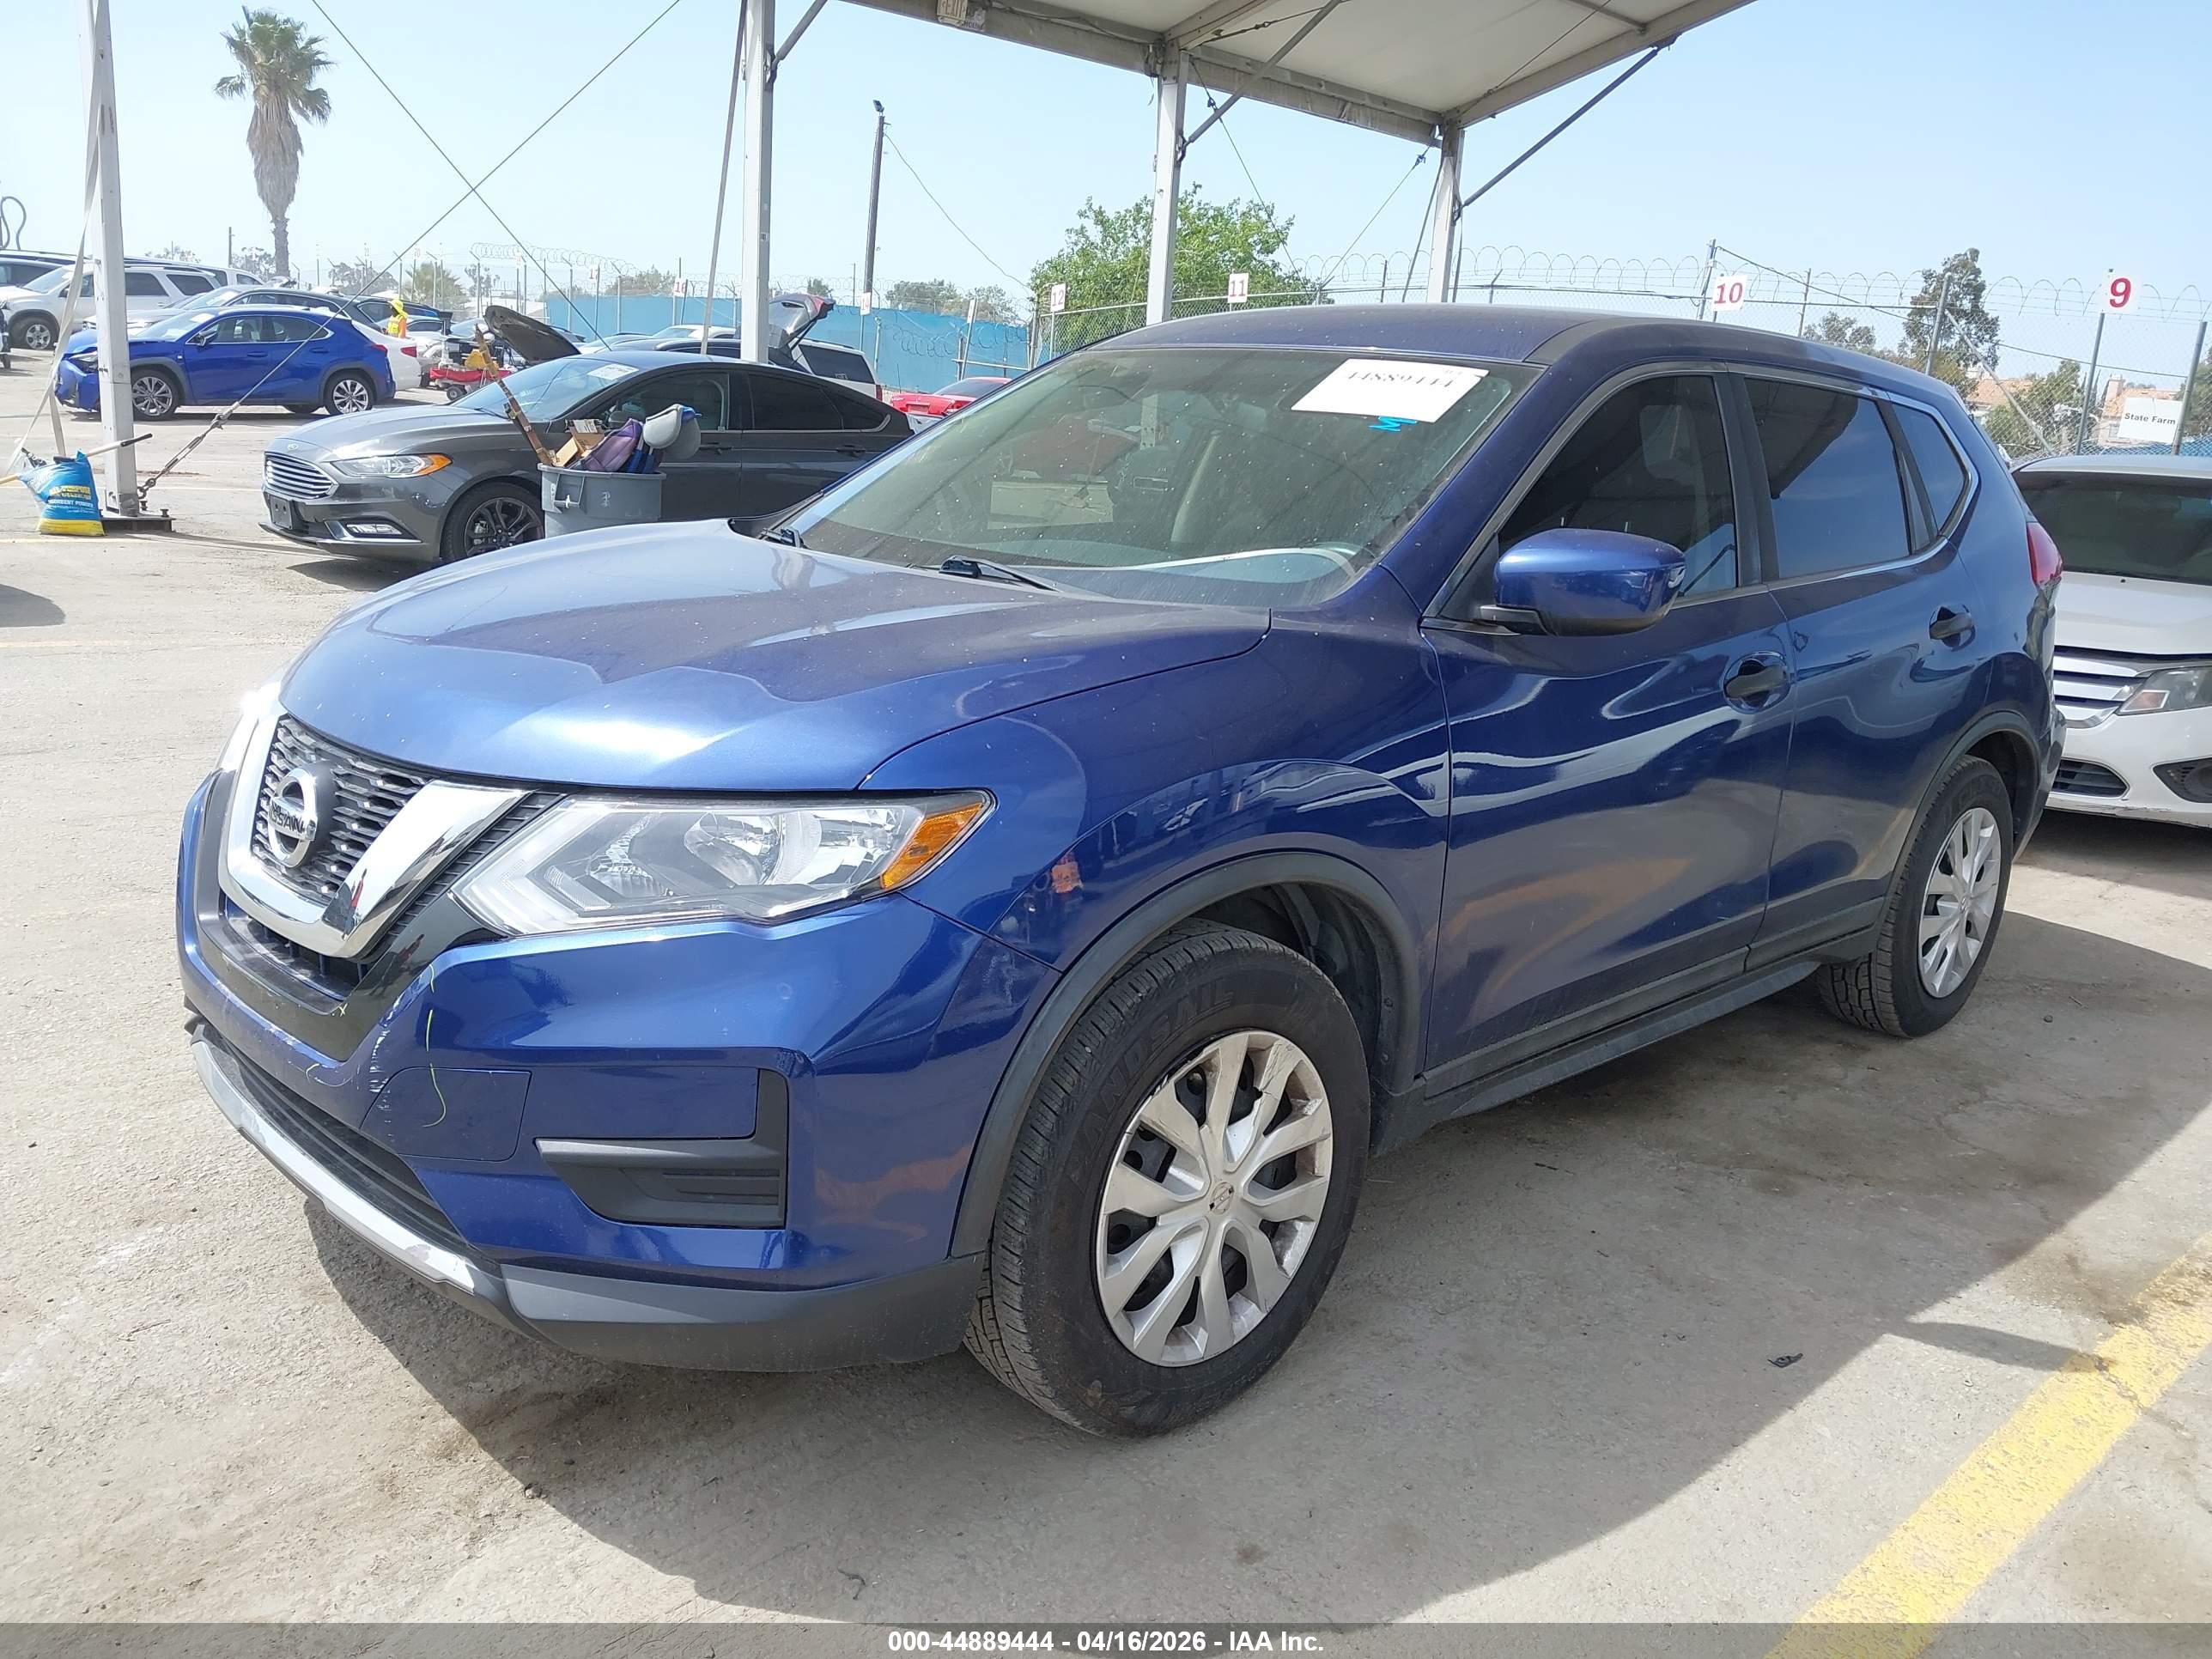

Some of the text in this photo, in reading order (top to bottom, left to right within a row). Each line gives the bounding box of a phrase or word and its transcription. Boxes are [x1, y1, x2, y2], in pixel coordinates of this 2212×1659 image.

[1230, 280, 1246, 297] 11
[1714, 283, 1743, 304] 10
[2110, 277, 2131, 308] 9
[1052, 289, 1064, 307] 12
[2124, 412, 2176, 425] State Farm
